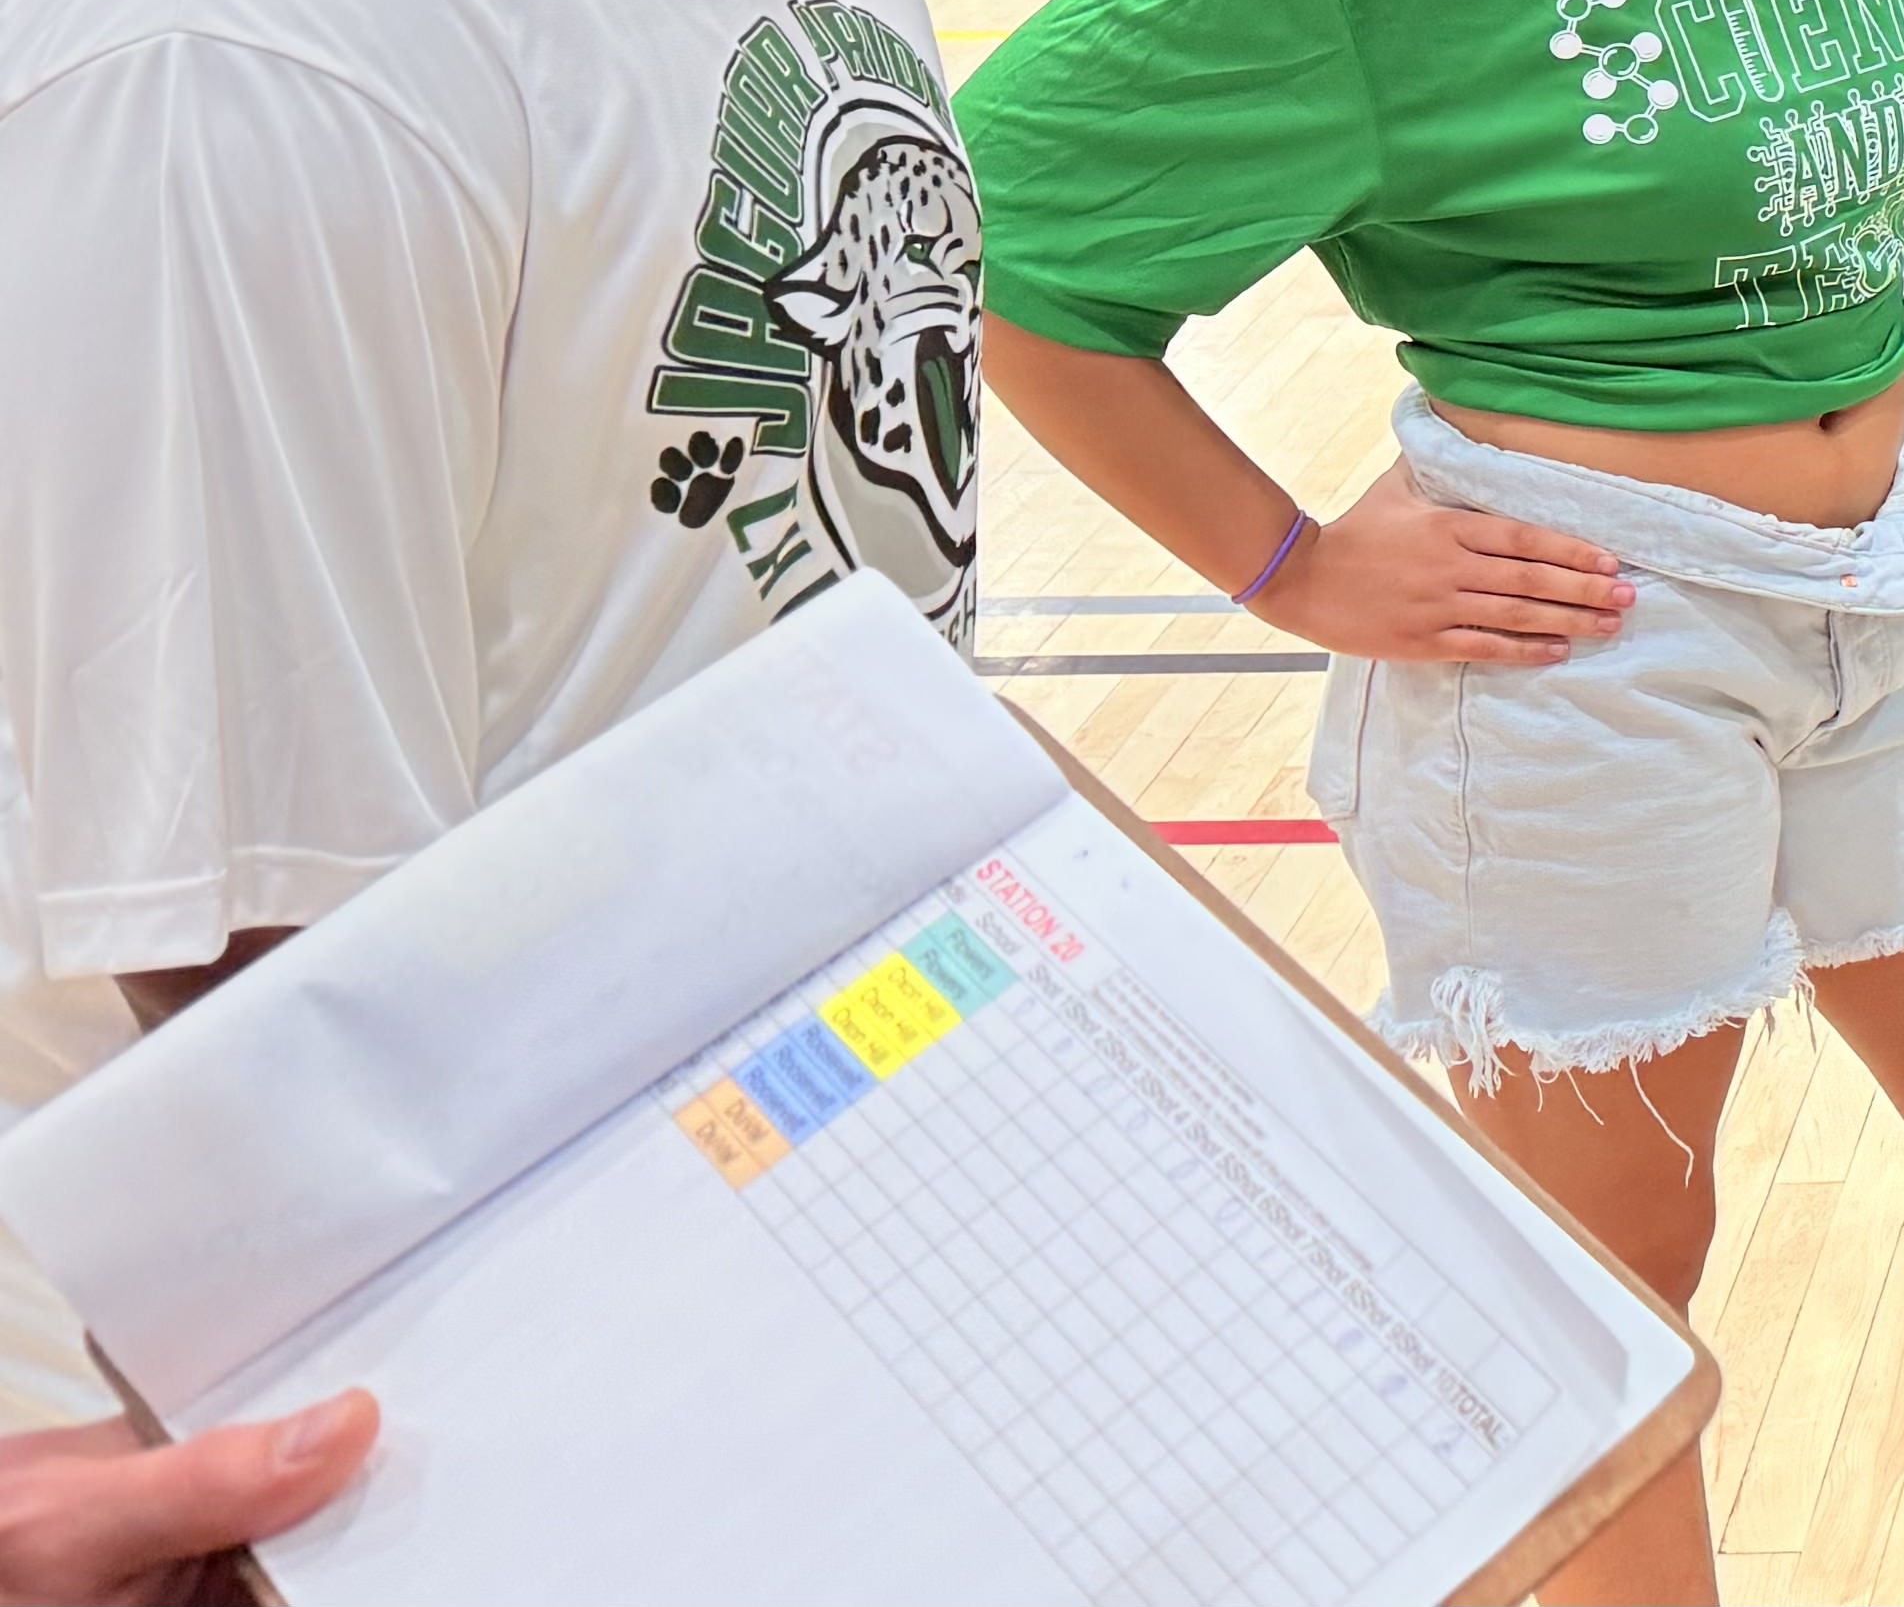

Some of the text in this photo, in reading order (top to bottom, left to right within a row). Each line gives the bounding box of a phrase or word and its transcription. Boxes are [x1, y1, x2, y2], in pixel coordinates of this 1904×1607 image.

[647, 16, 828, 457] JAGUAR
[946, 927, 995, 981] Flowers
[976, 858, 1060, 940] STATION
[1049, 922, 1086, 964] 20
[918, 947, 966, 1001] Flowers
[977, 910, 1020, 958] School
[1449, 1381, 1504, 1446] TOTAL
